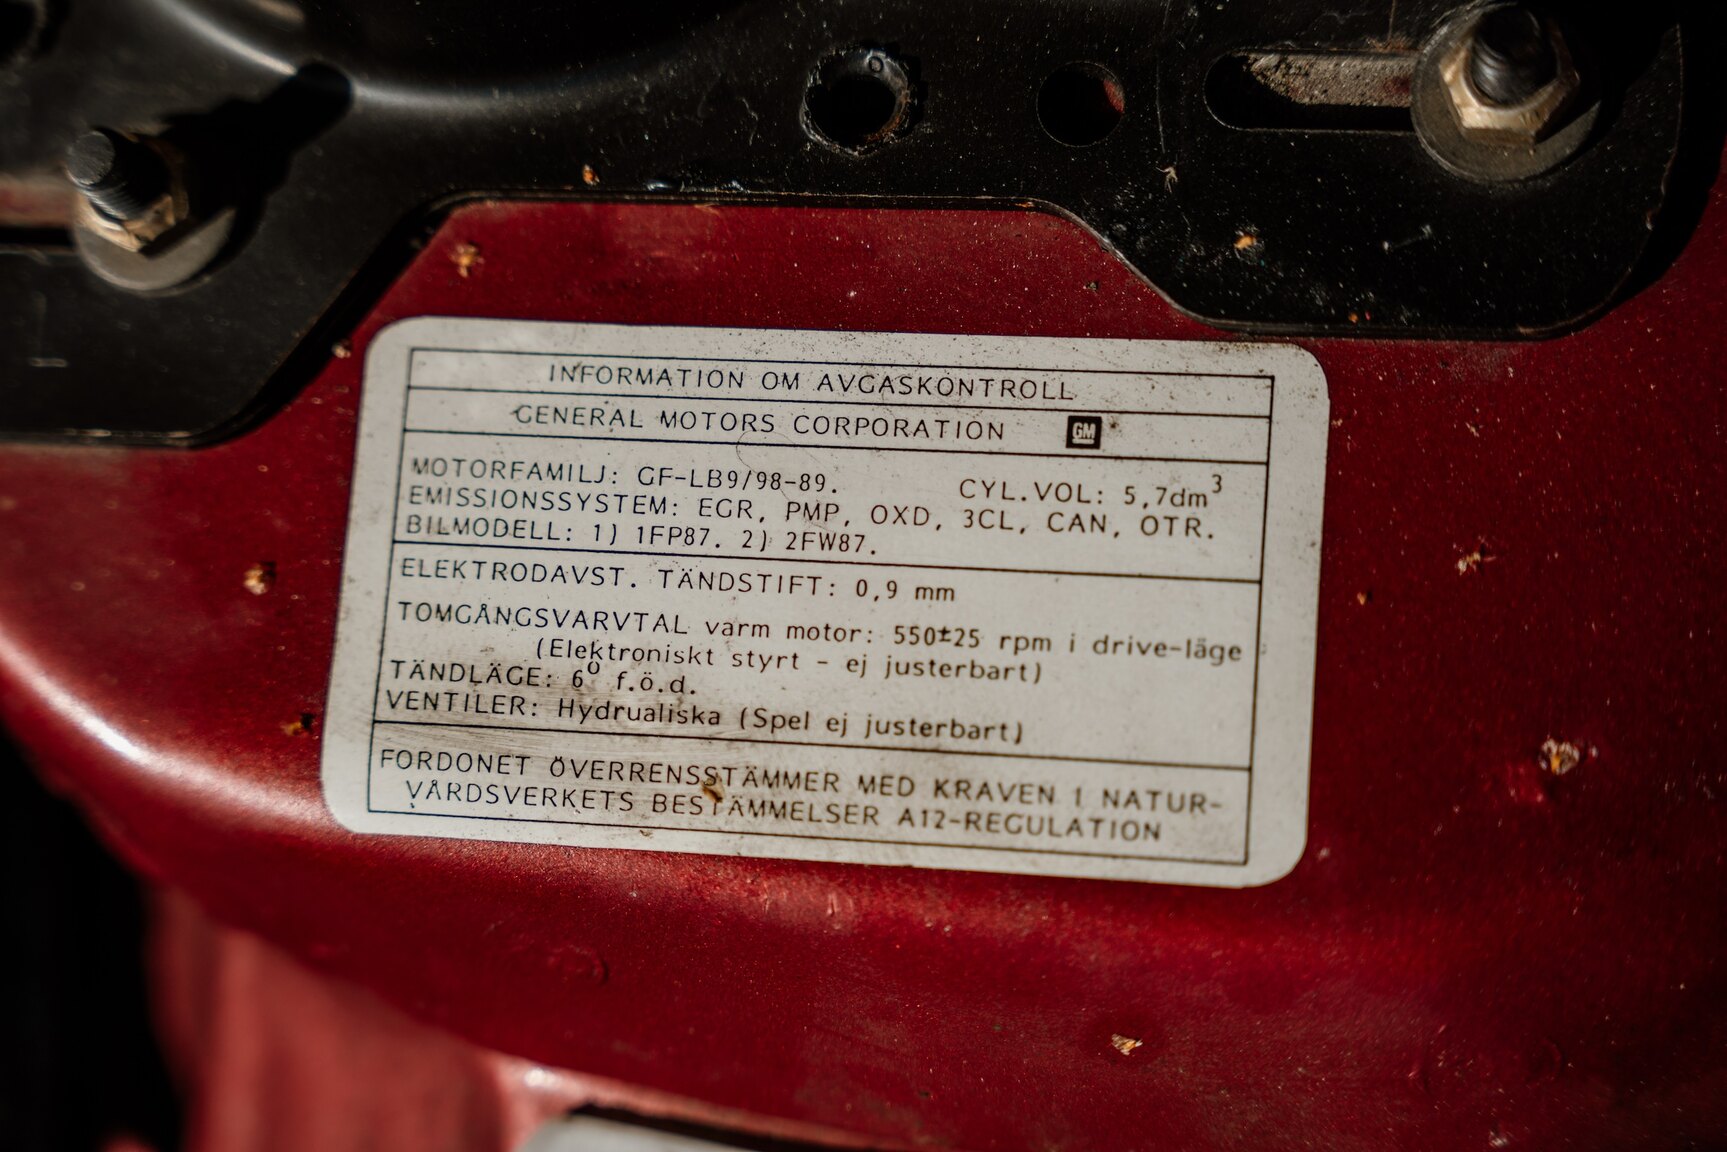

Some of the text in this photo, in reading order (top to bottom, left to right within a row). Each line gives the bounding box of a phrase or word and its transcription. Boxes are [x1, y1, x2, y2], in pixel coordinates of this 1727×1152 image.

[549, 363, 1074, 401] INFORMATION OM AVGASKONTROLL
[515, 404, 1005, 441] GENERAL MOTORS CORPORATION
[410, 457, 838, 495] MOTORFAMILJ: GF-LB9/98-89.
[959, 479, 1104, 505] CYL.VOL:
[409, 486, 1215, 540] EMISSIONSSYSTEM: EGR, PMP, OXD, 3CL, CAN, OTR.
[405, 515, 877, 556] BILMODELL: 1) 1FP87. 2) 2FW87.
[400, 558, 956, 602] ELEKTRODAVST. TÄNDSTIFT: 0,9 mm
[398, 601, 1242, 667] TOMGÅNGSVARVTAL varm motor: 550±25 rpm i drive-läge
[391, 659, 552, 689] TÄNDLÄGE:
[617, 670, 695, 695] f.ö.d.
[536, 638, 714, 668] (Elektroniskt
[732, 650, 800, 673] styrt
[846, 656, 868, 678] ej
[884, 656, 1042, 683] justerbart)
[386, 690, 1023, 745] VENTILER: Hydrualiska (Spel ej justerbart)
[381, 749, 1222, 814] FORDONET ÖVERRENSSTÄMMER MED KRAVEN I NATUR-
[406, 779, 1161, 841] VÅRDSVERKETS BESTÄMMELSER A12-REGULATION
